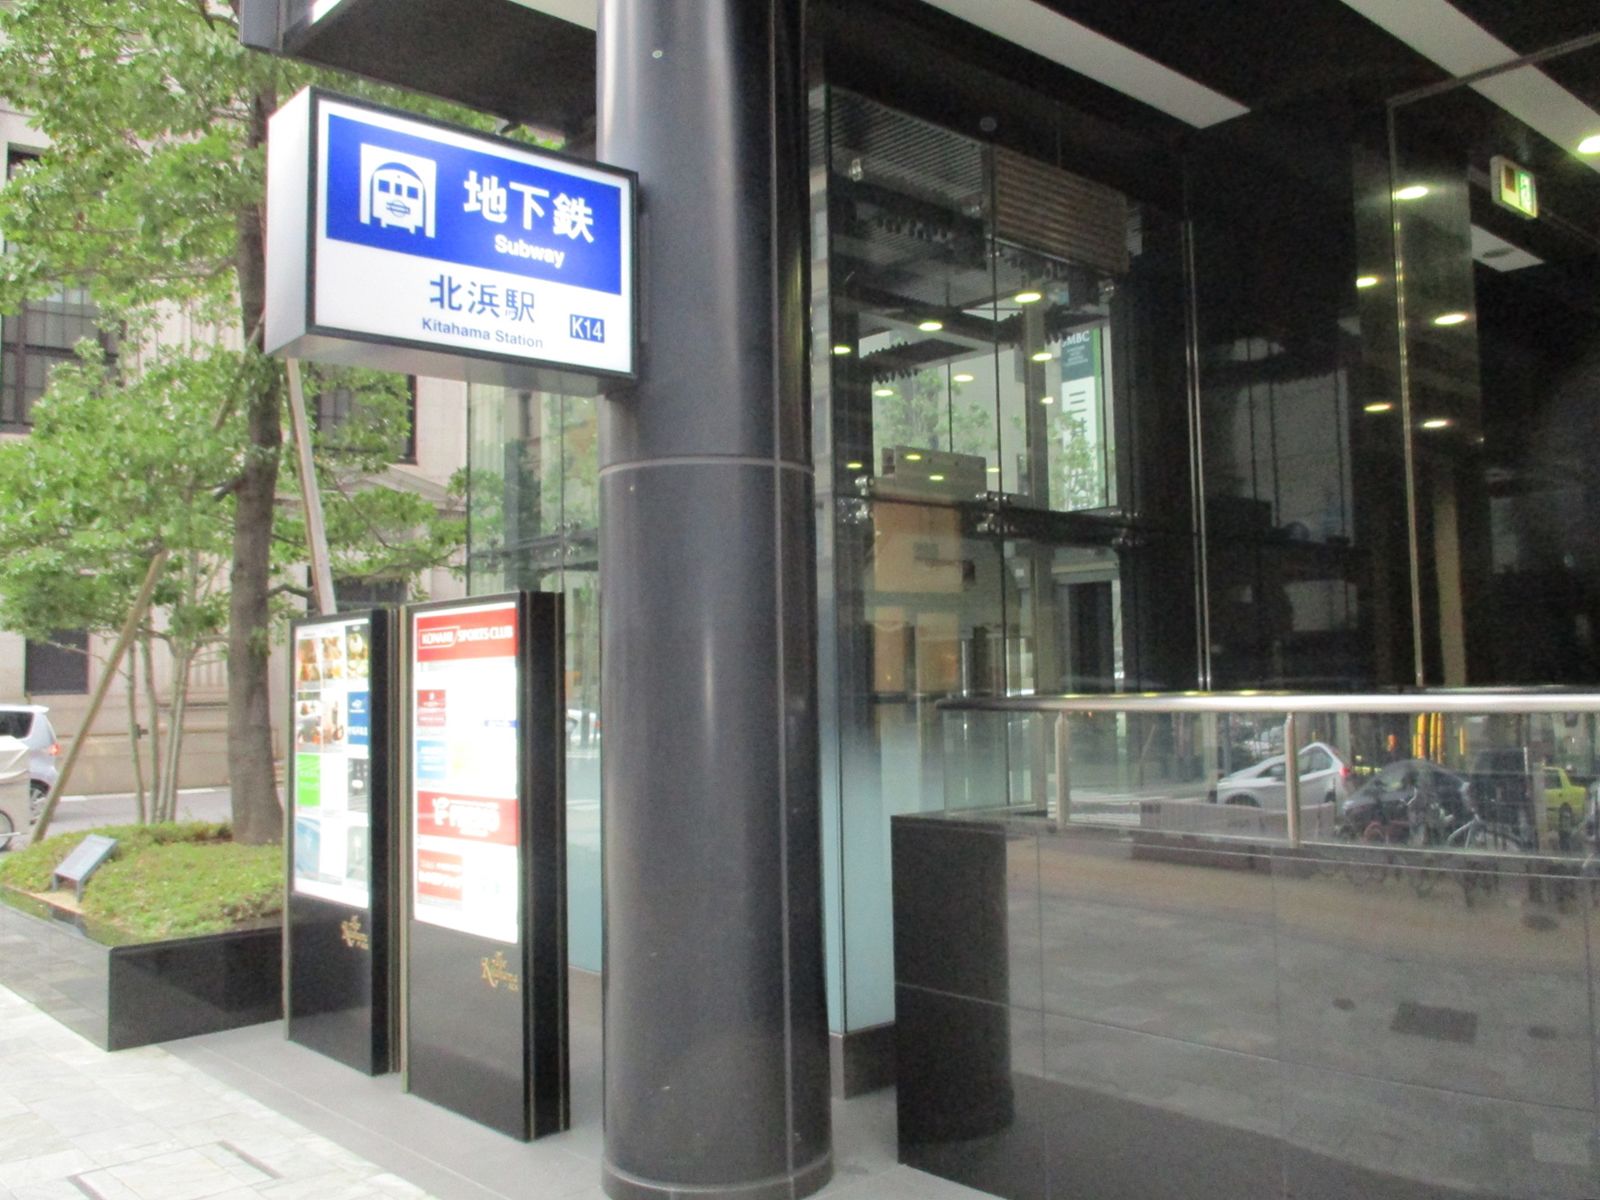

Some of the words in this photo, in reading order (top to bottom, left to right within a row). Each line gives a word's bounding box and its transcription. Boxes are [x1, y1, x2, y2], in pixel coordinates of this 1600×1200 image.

[463, 171, 595, 244] 地下鉄
[494, 234, 565, 268] Subway
[429, 274, 535, 323] 北浜駅
[422, 317, 491, 341] Kitahama
[495, 329, 544, 349] Station
[571, 316, 605, 342] K14
